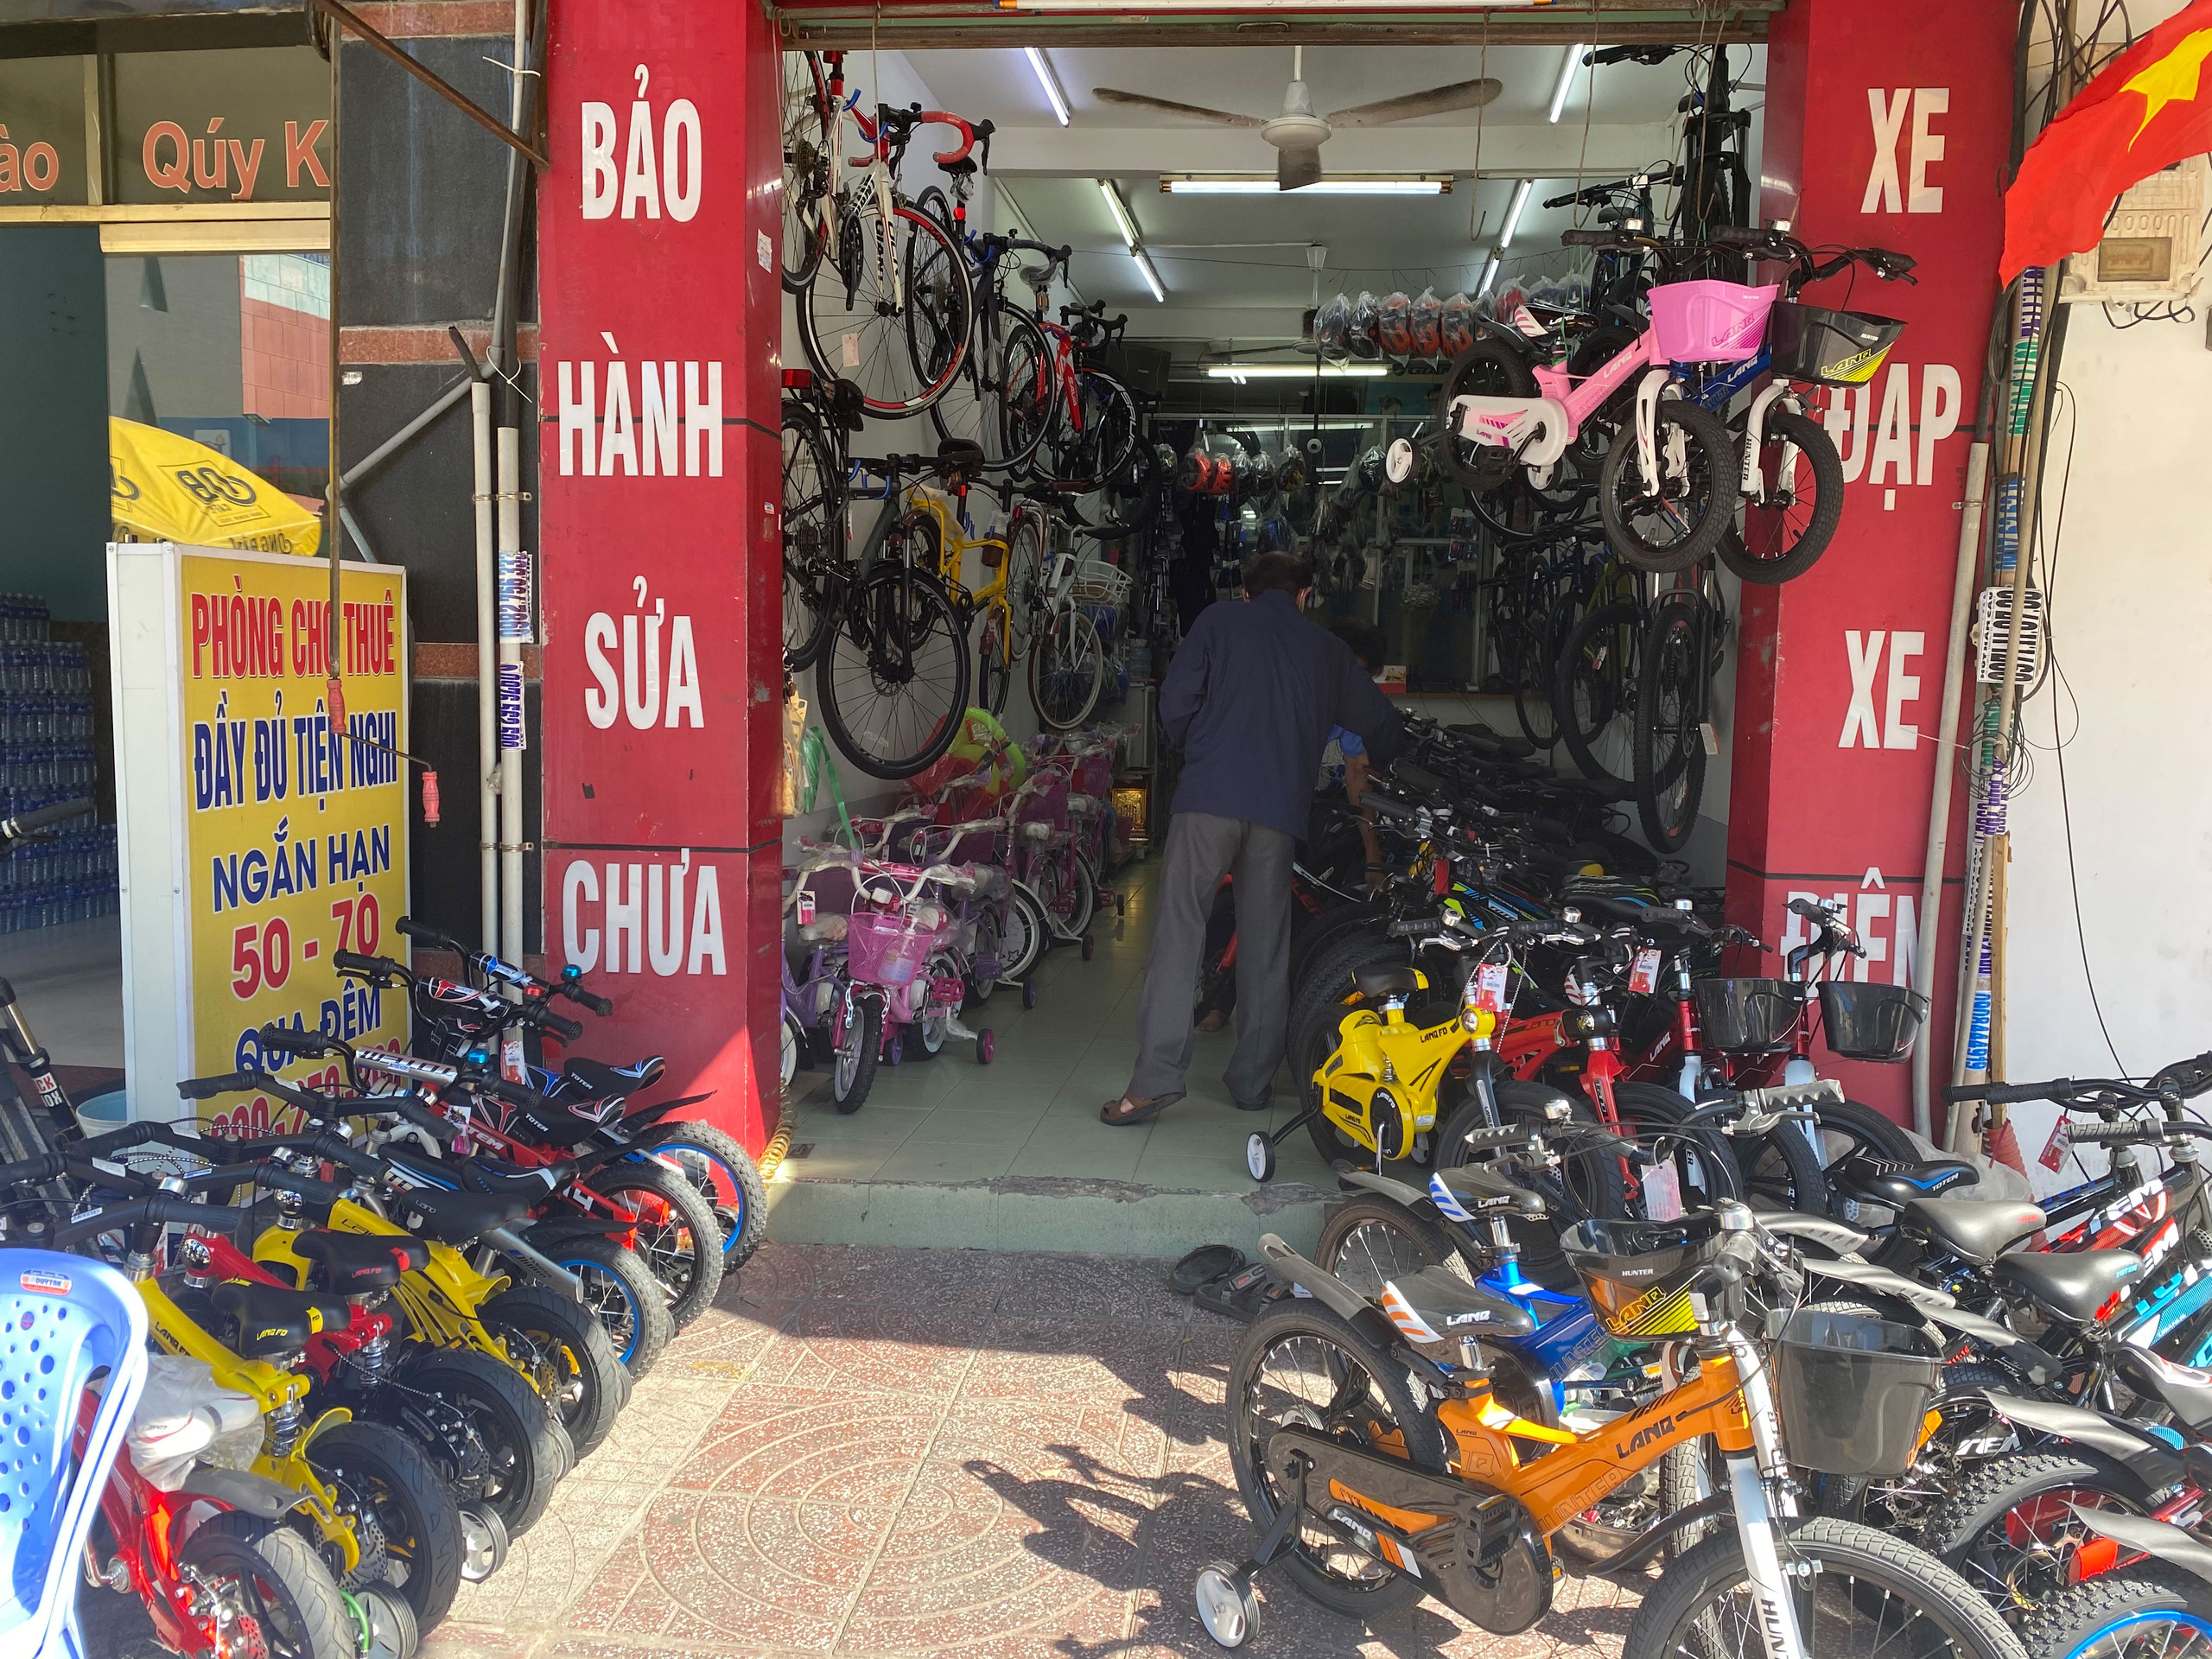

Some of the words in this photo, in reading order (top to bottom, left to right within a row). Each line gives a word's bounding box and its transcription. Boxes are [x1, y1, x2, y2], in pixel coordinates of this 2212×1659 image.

[143, 117, 264, 200] Qúy
[581, 63, 702, 222] BẢO
[1860, 87, 1950, 213] XE
[557, 331, 723, 477] HÀNH
[1742, 437, 1753, 481] HUNTER
[190, 574, 284, 680] PHÒNG
[290, 597, 333, 678] CHO
[342, 589, 395, 677] THUÊ
[584, 575, 705, 730] SỬA
[1837, 630, 1926, 751] XE
[194, 690, 246, 811] ĐẦY
[254, 689, 288, 802] ĐỦ
[293, 697, 346, 812] TIỆN
[349, 709, 397, 792] NGHI
[213, 816, 318, 913] NGẮN
[327, 823, 391, 893] HẠN
[562, 847, 728, 976] CHƯA
[230, 916, 290, 1001] 50
[331, 893, 380, 958] 70
[320, 979, 380, 1044] ĐÊM
[1649, 1031, 1671, 1063] LANQ
[36, 1076, 54, 1092] CK
[41, 1090, 63, 1107] OX
[570, 1071, 594, 1090] TOTEM
[467, 1126, 505, 1151] TEM
[525, 1112, 550, 1133] TOTEM
[1477, 1194, 1511, 1210] LANQ
[1931, 1172, 1960, 1192] TOTEM
[1621, 1268, 1654, 1277] HUNTER
[1446, 1309, 1491, 1327] LANQ
[1605, 1285, 1669, 1332] LANQ
[256, 1330, 276, 1341] LANQ
[1615, 1414, 1676, 1459] LANQ
[1332, 1508, 1373, 1542] LANQ
